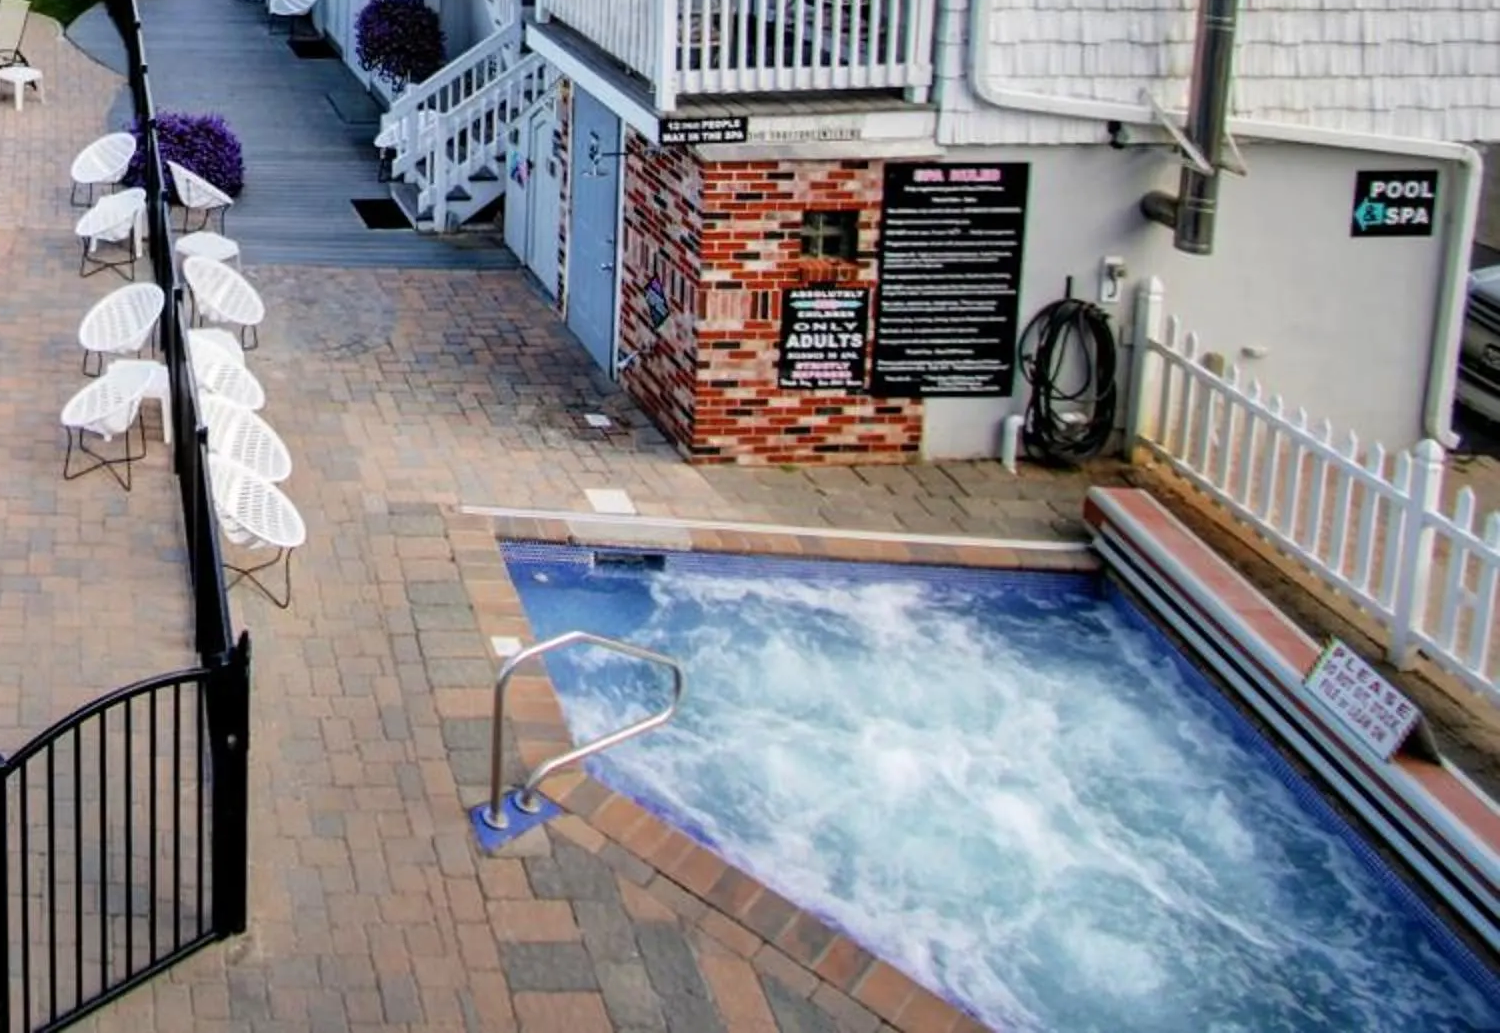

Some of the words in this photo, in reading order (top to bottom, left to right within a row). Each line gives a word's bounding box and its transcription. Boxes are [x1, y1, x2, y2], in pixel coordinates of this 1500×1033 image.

[701, 120, 741, 129] PEOPLE
[663, 133, 686, 142] MAX
[702, 132, 722, 141] THE
[1370, 181, 1435, 198] POOL
[1385, 206, 1429, 225] SPA
[789, 290, 864, 298] ABSOLUTELY
[796, 310, 856, 318] CHILDREN
[792, 322, 859, 332] ONLY
[785, 333, 864, 348] ADULTS
